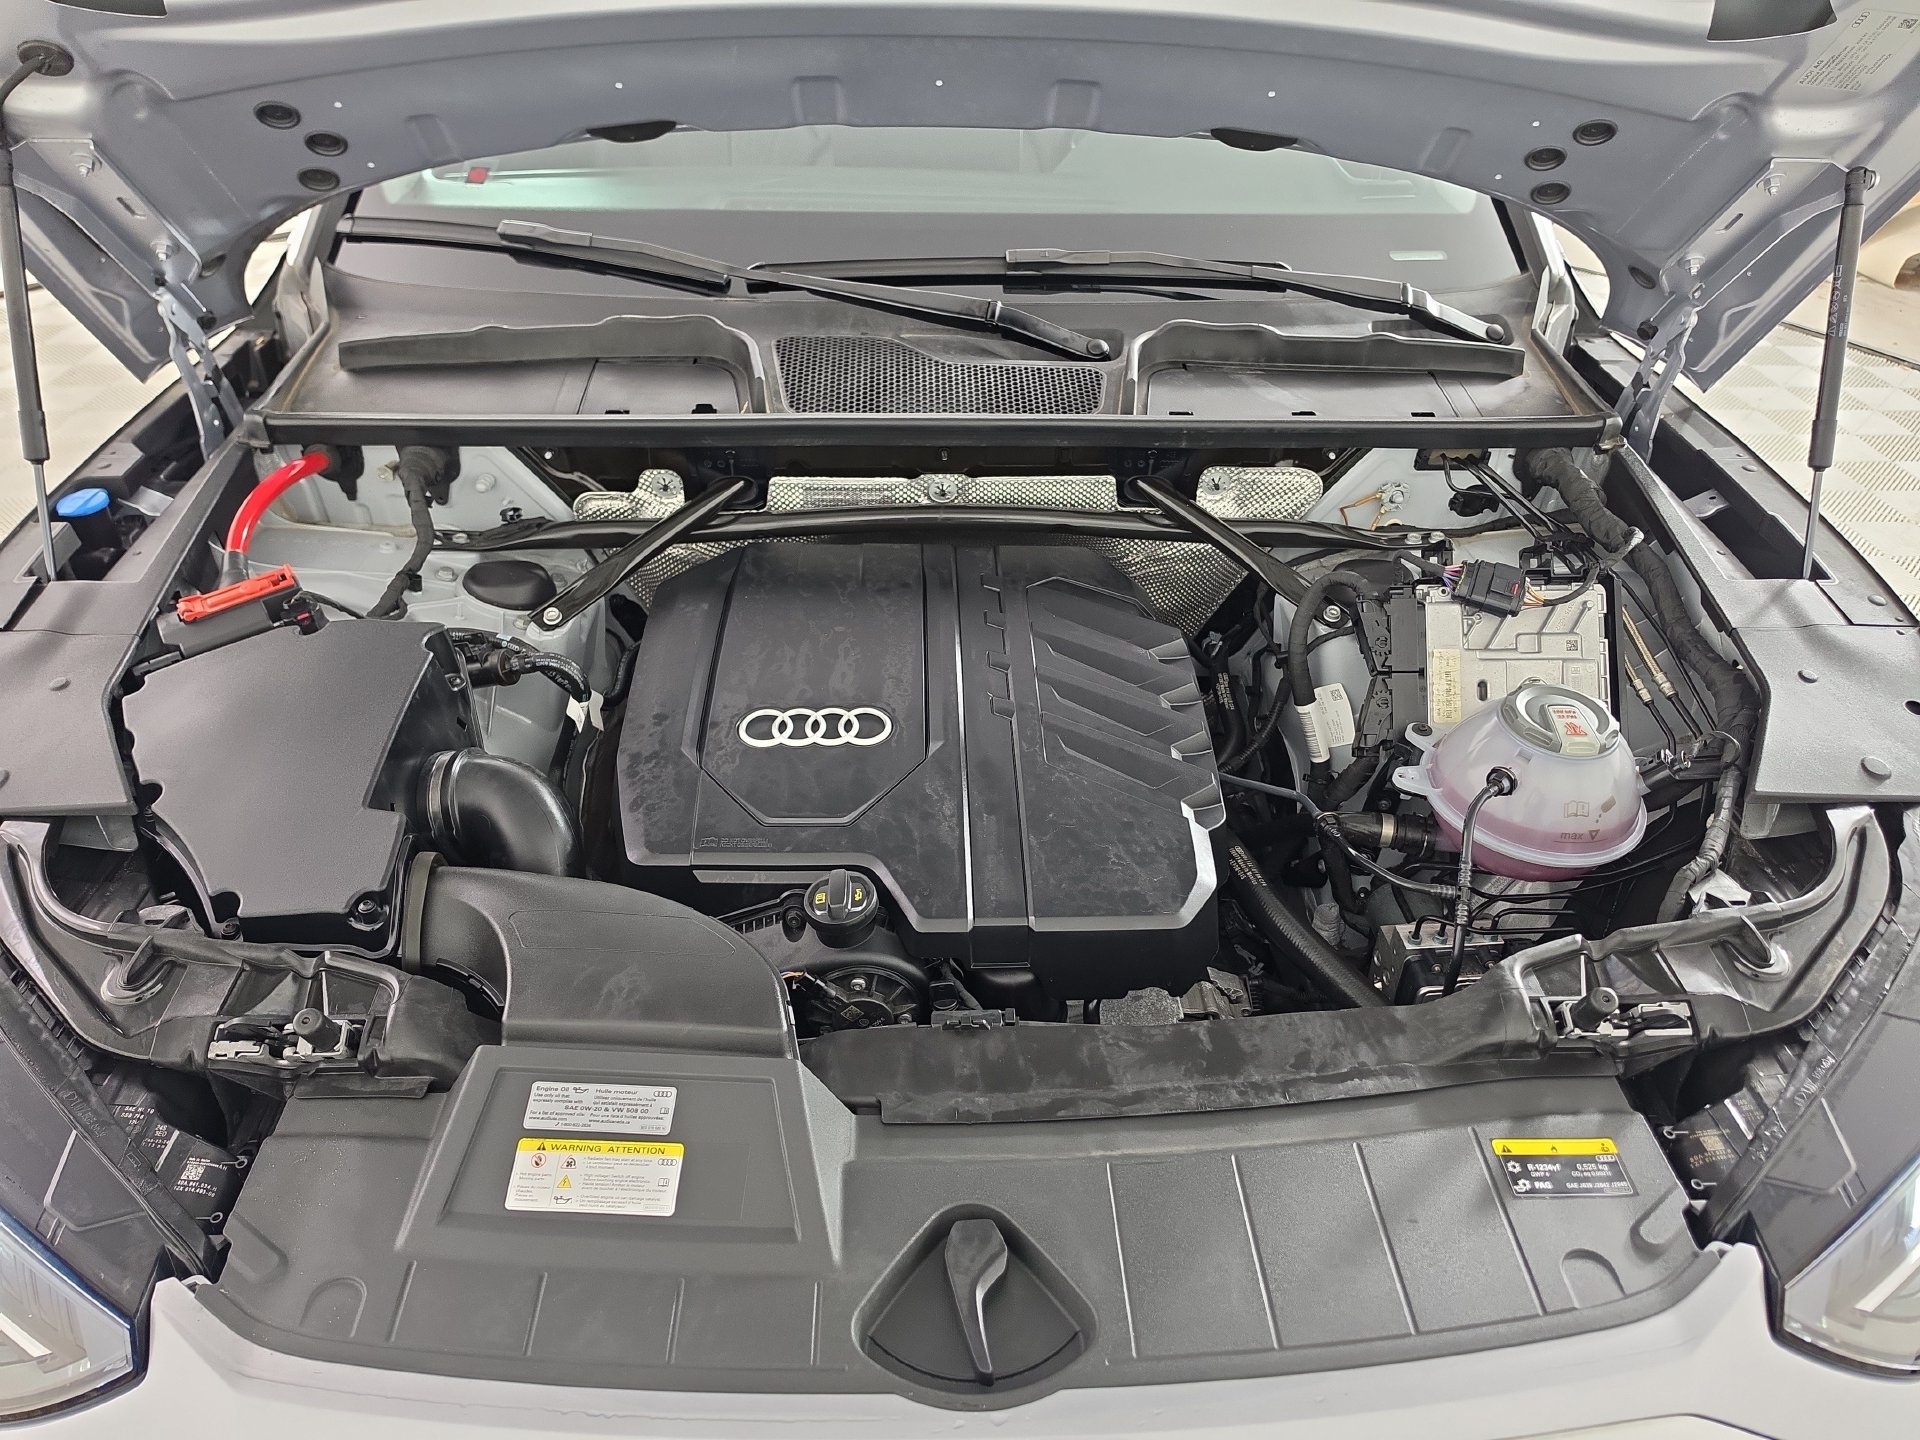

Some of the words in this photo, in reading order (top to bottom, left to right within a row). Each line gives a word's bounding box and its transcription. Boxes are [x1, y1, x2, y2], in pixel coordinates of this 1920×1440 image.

[1799, 70, 1814, 84] AUDI
[1560, 831, 1584, 840] max
[550, 1143, 602, 1152] WARNING
[607, 1146, 666, 1155] ATTENTION
[1527, 1163, 1560, 1172] R-1234yf
[1534, 1181, 1553, 1189] PAG
